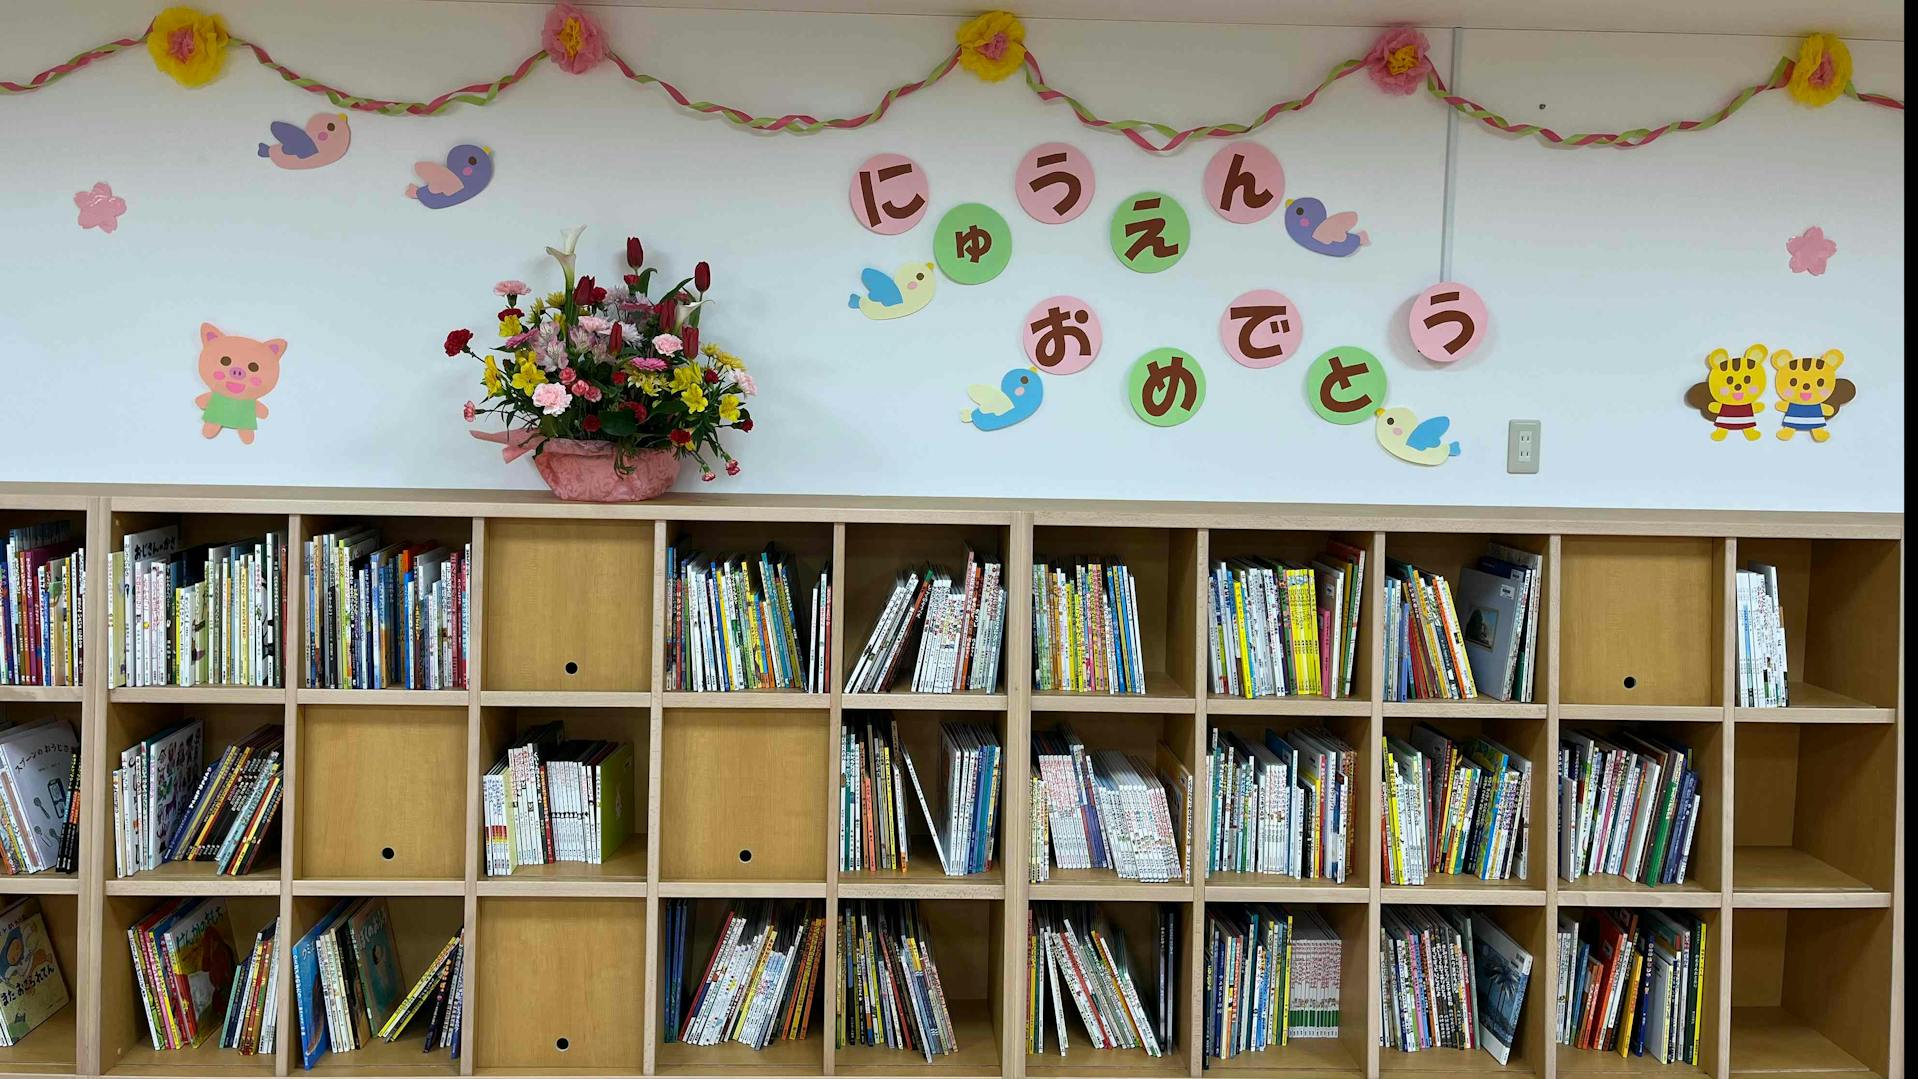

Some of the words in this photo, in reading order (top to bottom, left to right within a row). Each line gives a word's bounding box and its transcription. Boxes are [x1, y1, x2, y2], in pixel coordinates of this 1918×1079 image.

[859, 152, 1276, 264] にゅうえん
[1030, 291, 1476, 417] おめでとう
[15, 743, 76, 774] スプーンのおうじさ
